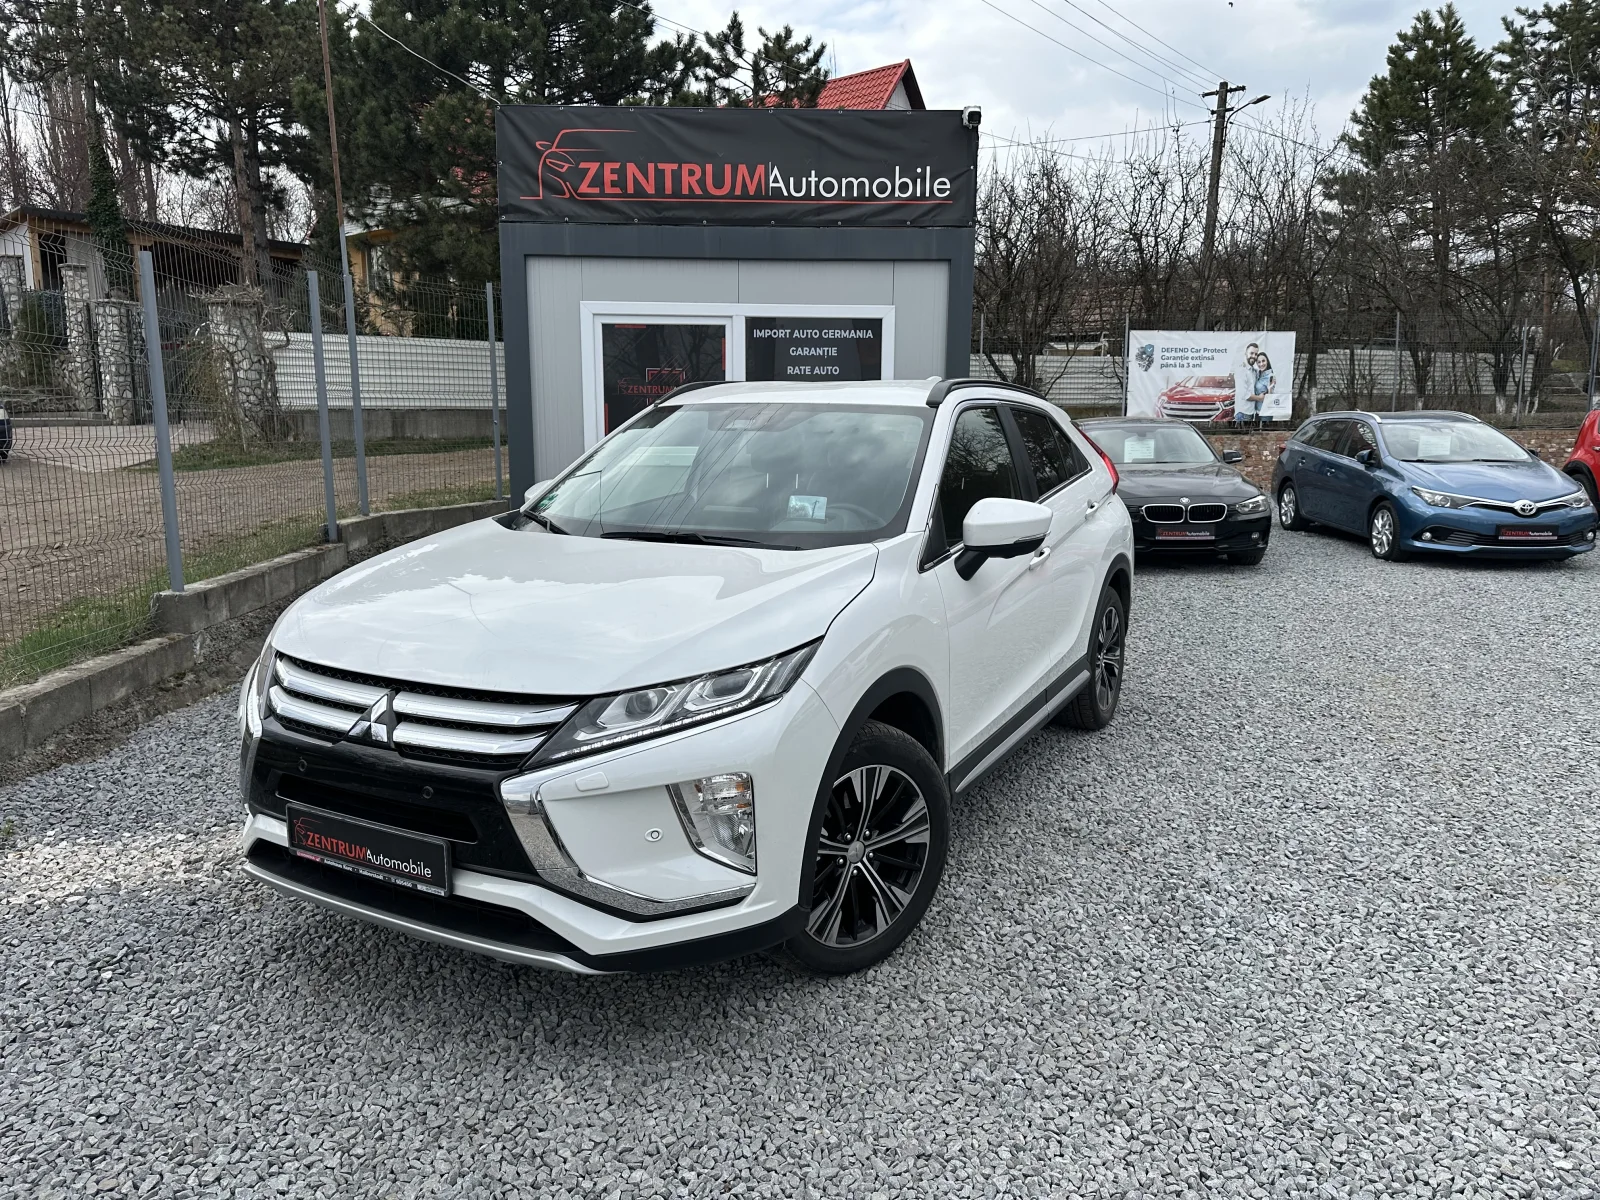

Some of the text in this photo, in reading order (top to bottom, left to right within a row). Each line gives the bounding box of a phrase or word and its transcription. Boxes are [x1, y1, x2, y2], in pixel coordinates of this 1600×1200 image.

[577, 162, 951, 198] ZENTRUM Automobile
[753, 329, 874, 339] IMPORT AUTO GERMANIA
[789, 347, 838, 359] GARANȚIE
[1160, 354, 1190, 362] Garanție
[1178, 361, 1185, 369] la
[1191, 361, 1203, 369] ani
[787, 366, 840, 375] RATE AUTO
[306, 831, 366, 860] ZENTRUM
[366, 848, 432, 878] Automobile
